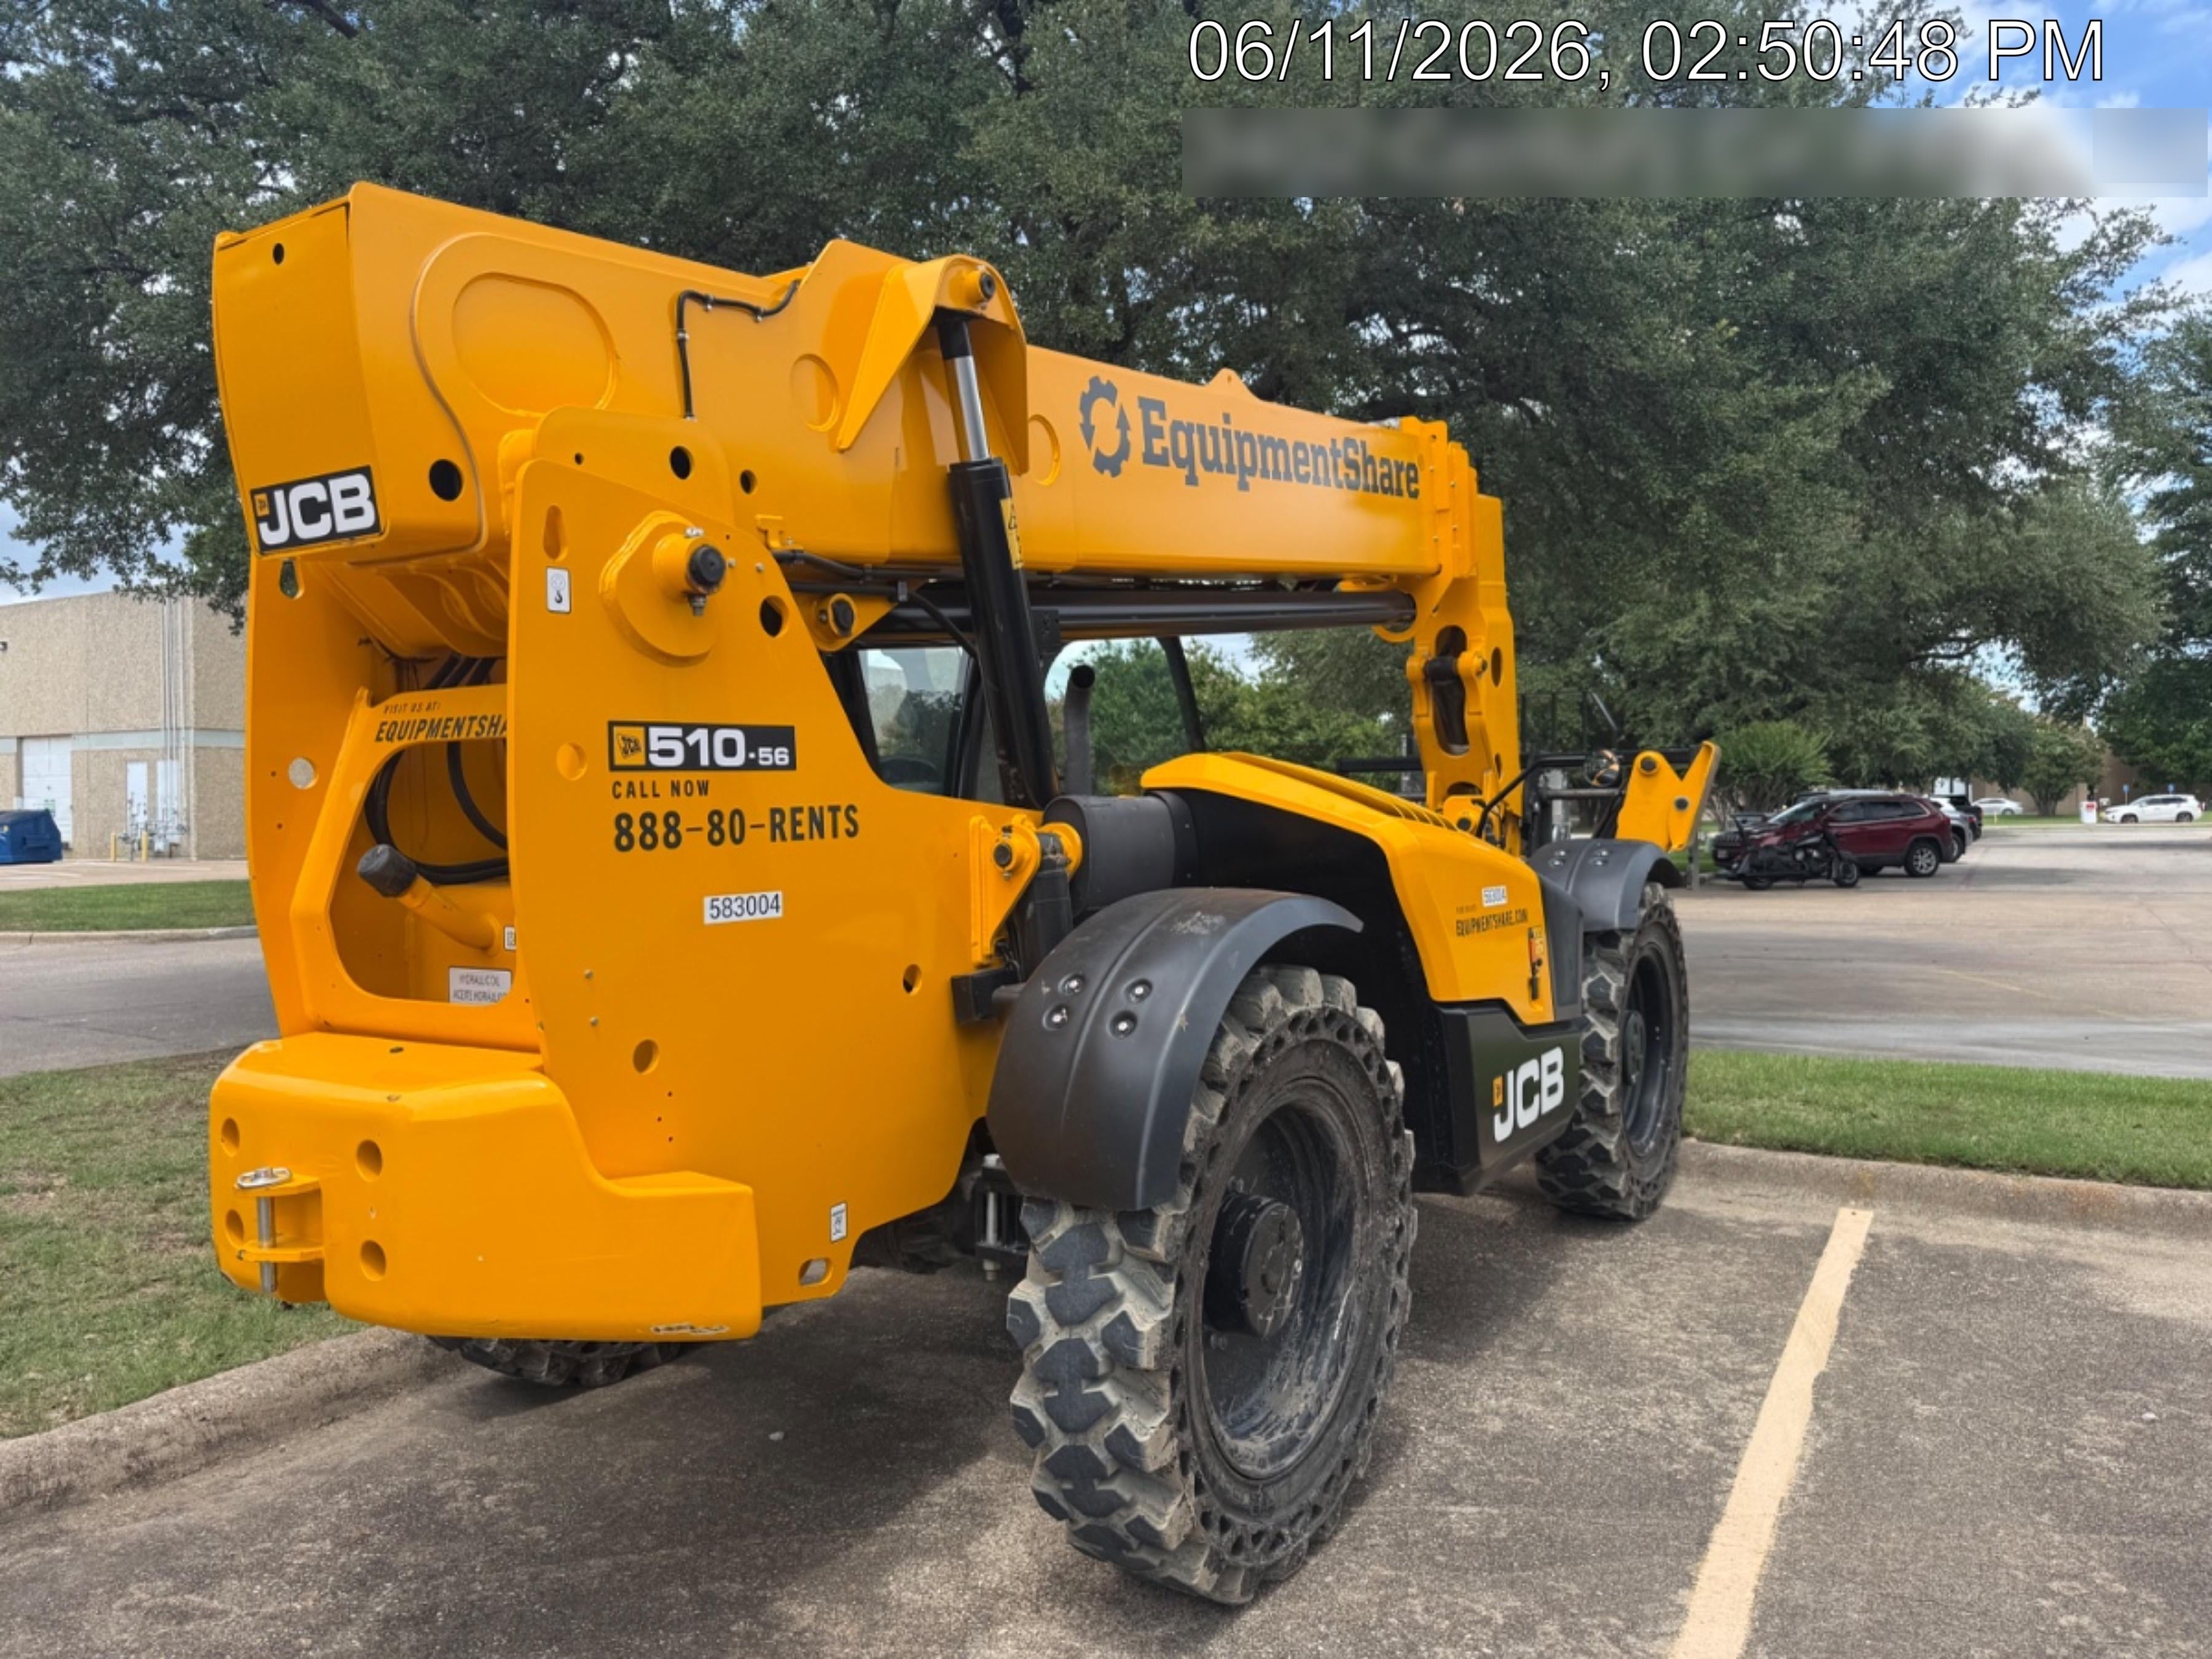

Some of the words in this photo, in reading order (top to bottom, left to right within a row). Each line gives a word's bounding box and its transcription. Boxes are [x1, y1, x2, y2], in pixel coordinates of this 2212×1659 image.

[1137, 396, 1420, 499] EquipmentShare
[258, 473, 375, 545] JCB
[612, 780, 661, 799] CALL
[670, 780, 710, 797] NOW
[614, 804, 859, 852] 888-80-RENTS
[709, 893, 781, 919] 583004
[1494, 1046, 1564, 1142] JCB
